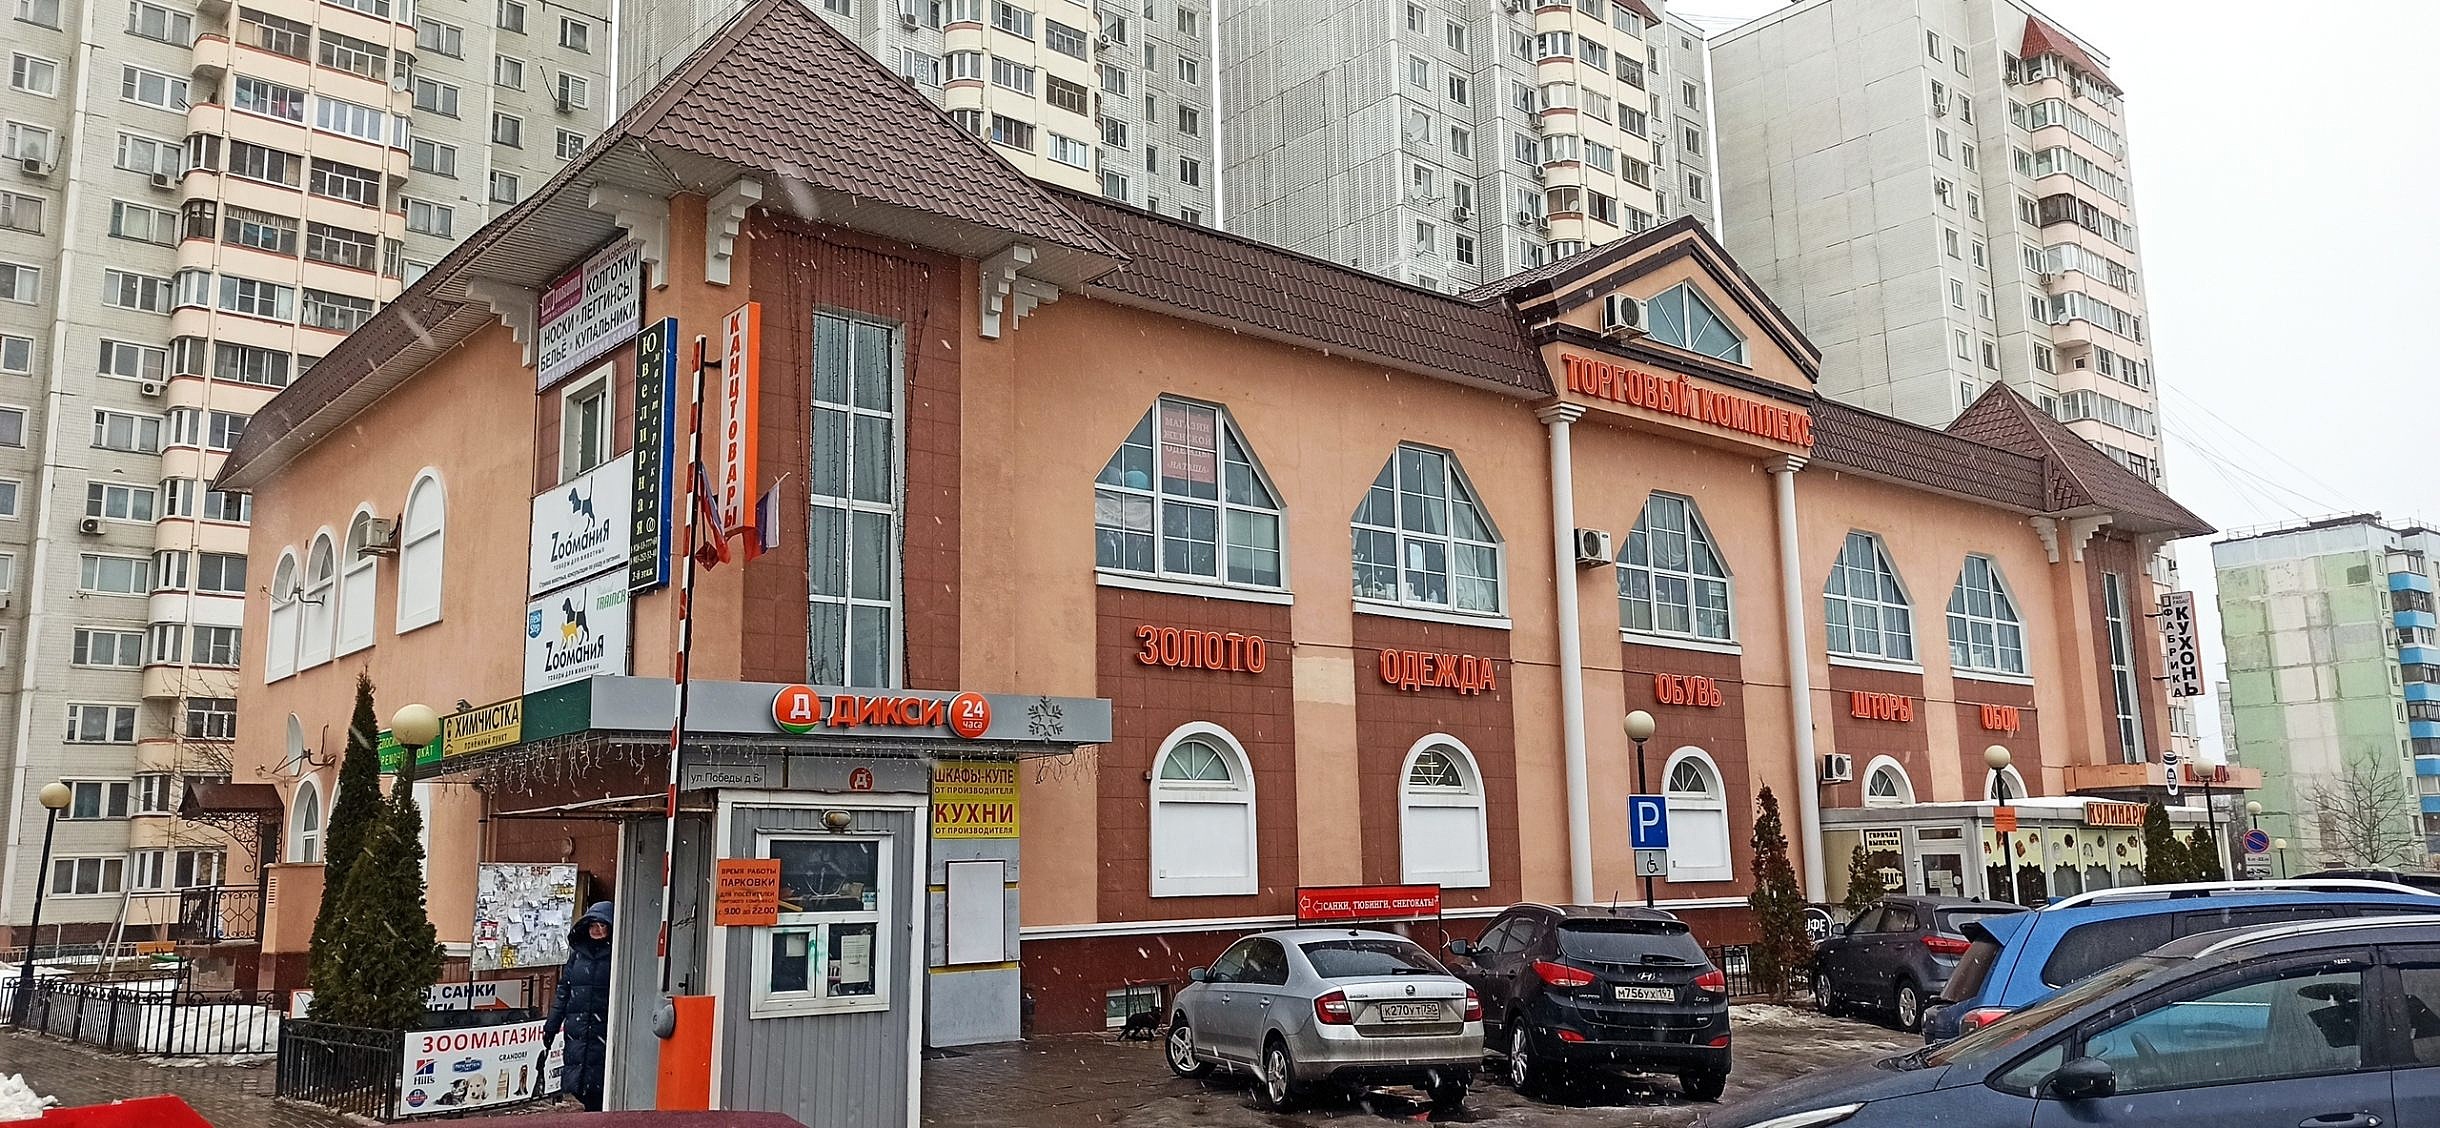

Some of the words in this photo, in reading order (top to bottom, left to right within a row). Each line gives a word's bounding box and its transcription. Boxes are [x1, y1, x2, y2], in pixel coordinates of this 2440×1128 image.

[586, 249, 637, 298] КОЛГОТКИ
[544, 313, 574, 348] НОСКИ
[581, 276, 633, 325] ЛЕГГИНСЫ
[540, 339, 567, 373] БЕЛЬЁ
[575, 300, 637, 351] КУПАЛЬНИКИ
[1562, 353, 1699, 419] ТОРГОВЫЙ
[1699, 387, 1814, 448] КОМПЛЕКС
[636, 332, 657, 536] Ювелирная
[648, 352, 661, 510] мастерская
[723, 313, 740, 528] КАНЦТОВАРЫ
[1165, 417, 1210, 433] МАГЗИН
[1136, 625, 1267, 674] ЗОЛОТО
[2163, 608, 2183, 698] ФАБРИКА
[2175, 606, 2199, 696] КУХОНЬ
[1380, 648, 1496, 695] ОДЕЖДА
[1655, 673, 1722, 707] ОБУВЬ
[1852, 690, 1914, 721] ШТОРЫ
[455, 701, 520, 739] ХИМЧИСТКА
[790, 694, 812, 719] Д
[828, 695, 945, 728] ДИКСИ
[962, 700, 985, 718] 24
[962, 720, 984, 729] часа
[1981, 704, 2020, 731] ОБОИ
[745, 775, 751, 783] д
[934, 786, 945, 794] ОТ
[947, 787, 1014, 795] ПРОИЗВОДИТЕЛЯ
[935, 767, 1014, 784] ШКАФЫ-КУПЕ
[935, 803, 1013, 824] КУХНИ
[1638, 802, 1660, 842] P
[2089, 804, 2146, 825] КУЛИНАРИ
[947, 827, 1013, 835] ПРОИЗВОДИТЕЛЯ
[721, 878, 776, 887] ПАРКОВКИ
[724, 907, 741, 915] 9.00
[752, 907, 776, 915] 22.00
[1323, 900, 1352, 911] САНКИ,
[1353, 900, 1392, 911] ТЮБИНГИ,
[442, 983, 496, 999] САНКИ
[422, 1024, 546, 1053] ЗООМАГАЗИН
